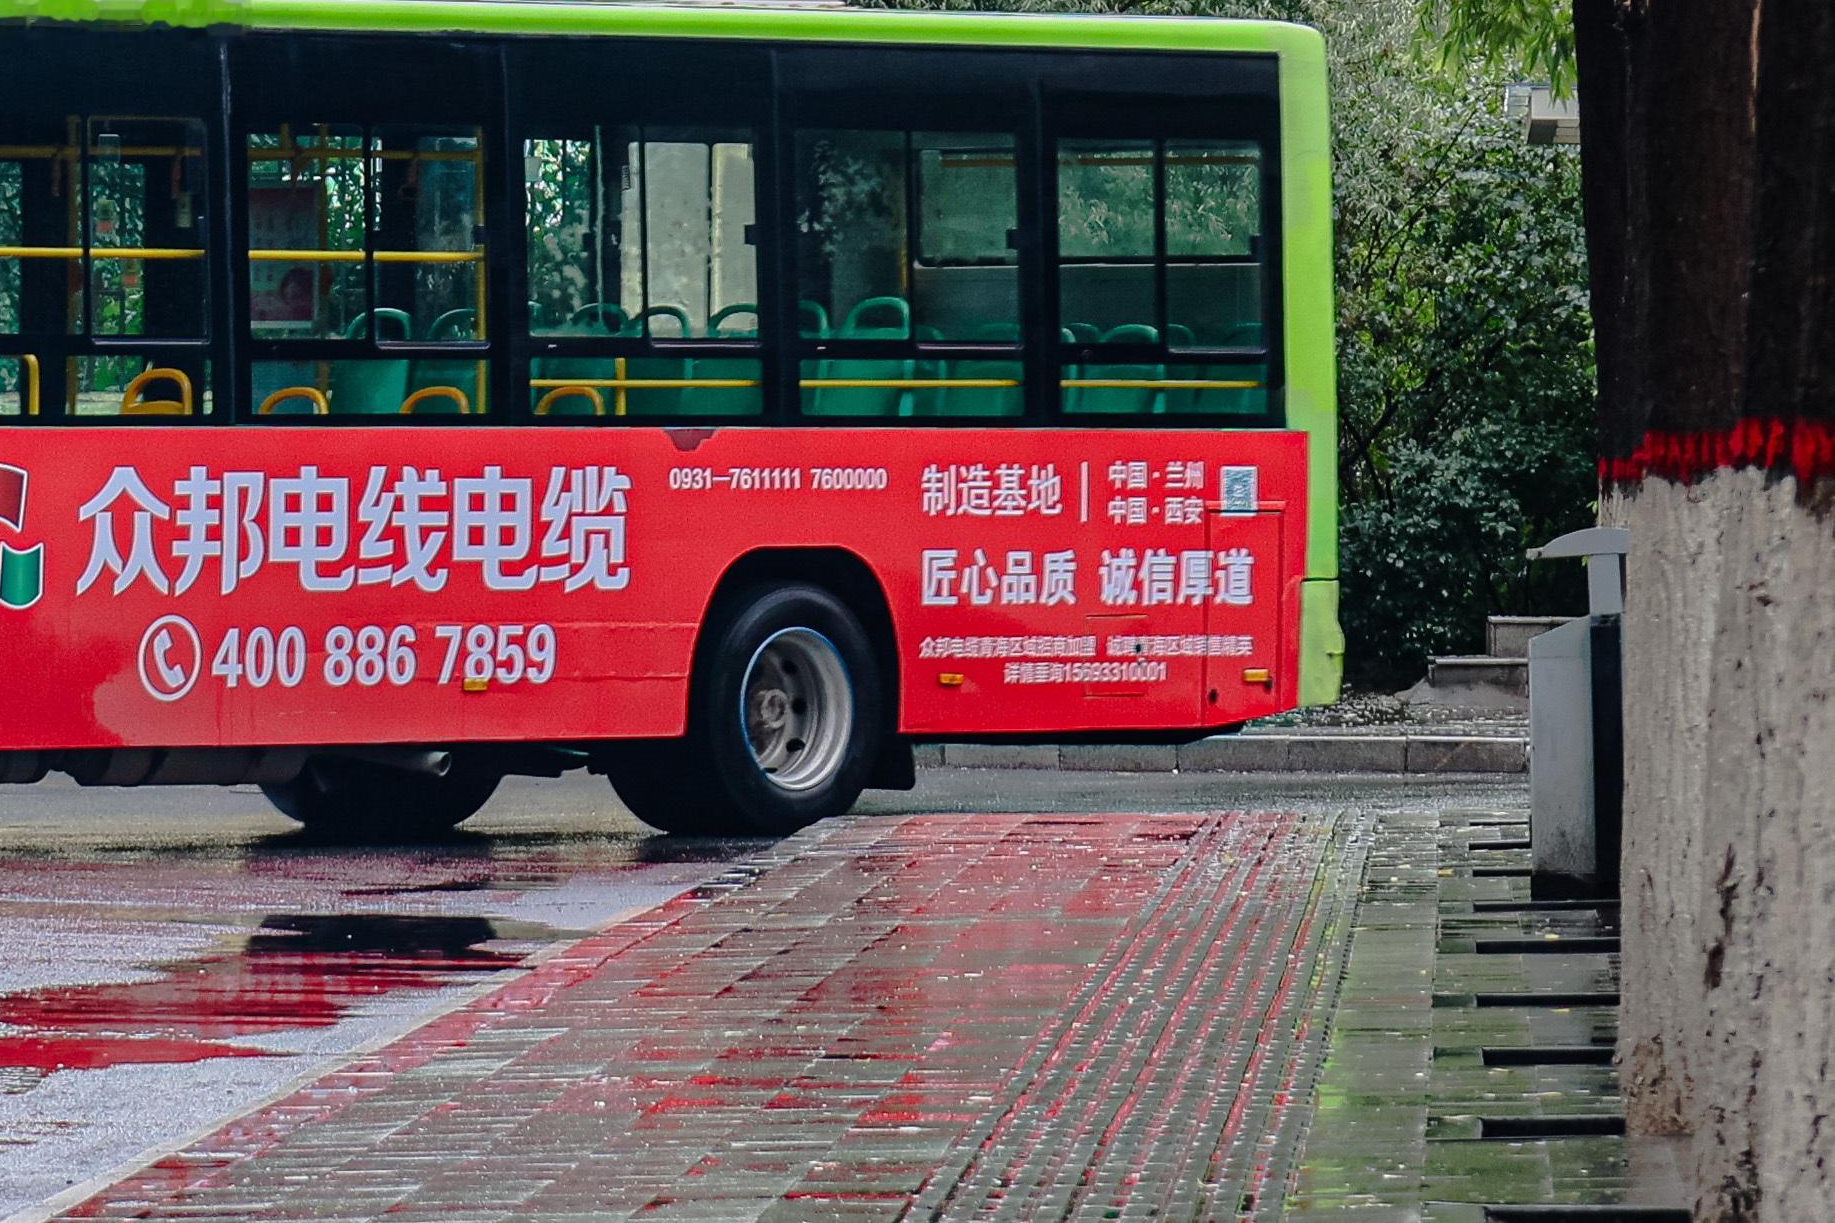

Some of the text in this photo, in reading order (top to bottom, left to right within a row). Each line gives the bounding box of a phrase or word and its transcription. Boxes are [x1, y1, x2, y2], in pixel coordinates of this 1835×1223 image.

[810, 467, 889, 489] 7600000
[921, 462, 1064, 518] 制造基地
[76, 465, 633, 596] 众邦电线电缆
[920, 547, 1255, 607] 匠心品质 诚信厚道
[211, 623, 557, 688] 400 886 7859
